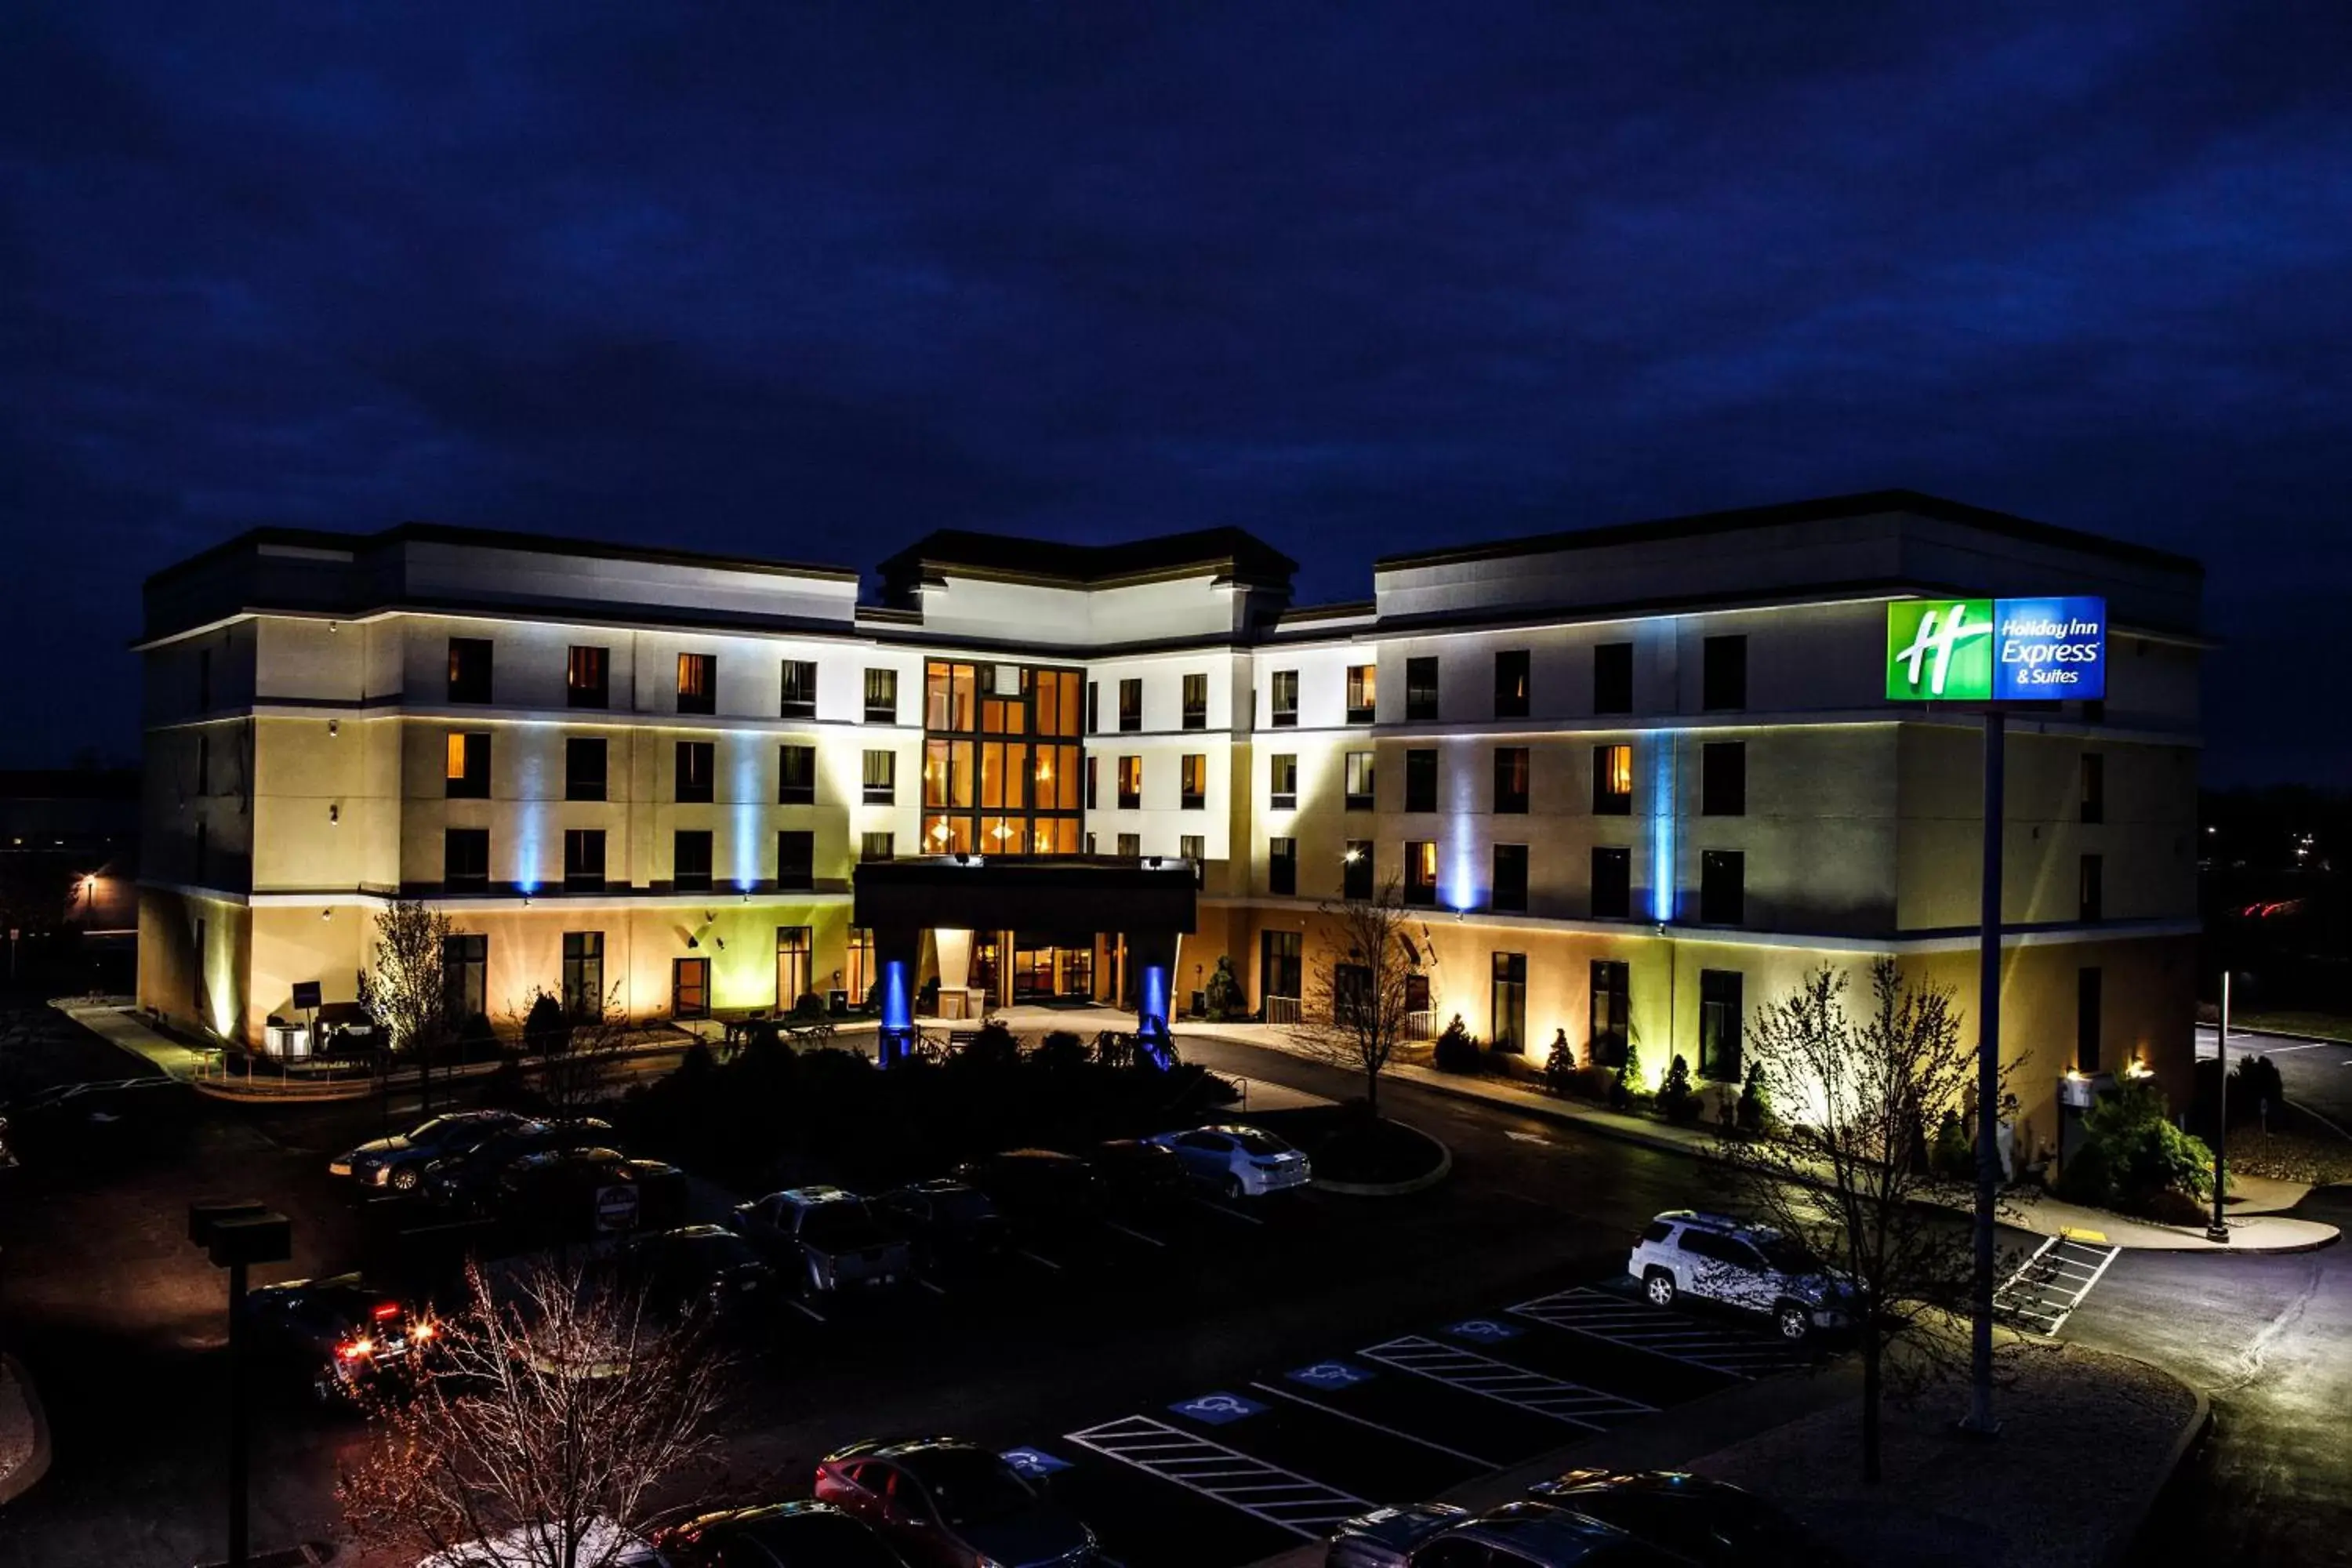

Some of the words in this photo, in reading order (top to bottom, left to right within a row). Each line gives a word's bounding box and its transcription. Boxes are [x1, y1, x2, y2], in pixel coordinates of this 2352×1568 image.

[2002, 619, 2067, 639] Holiday
[2070, 619, 2098, 634] Inn
[2002, 640, 2097, 667] Express
[2016, 669, 2029, 684] &
[2031, 669, 2078, 684] Suites
